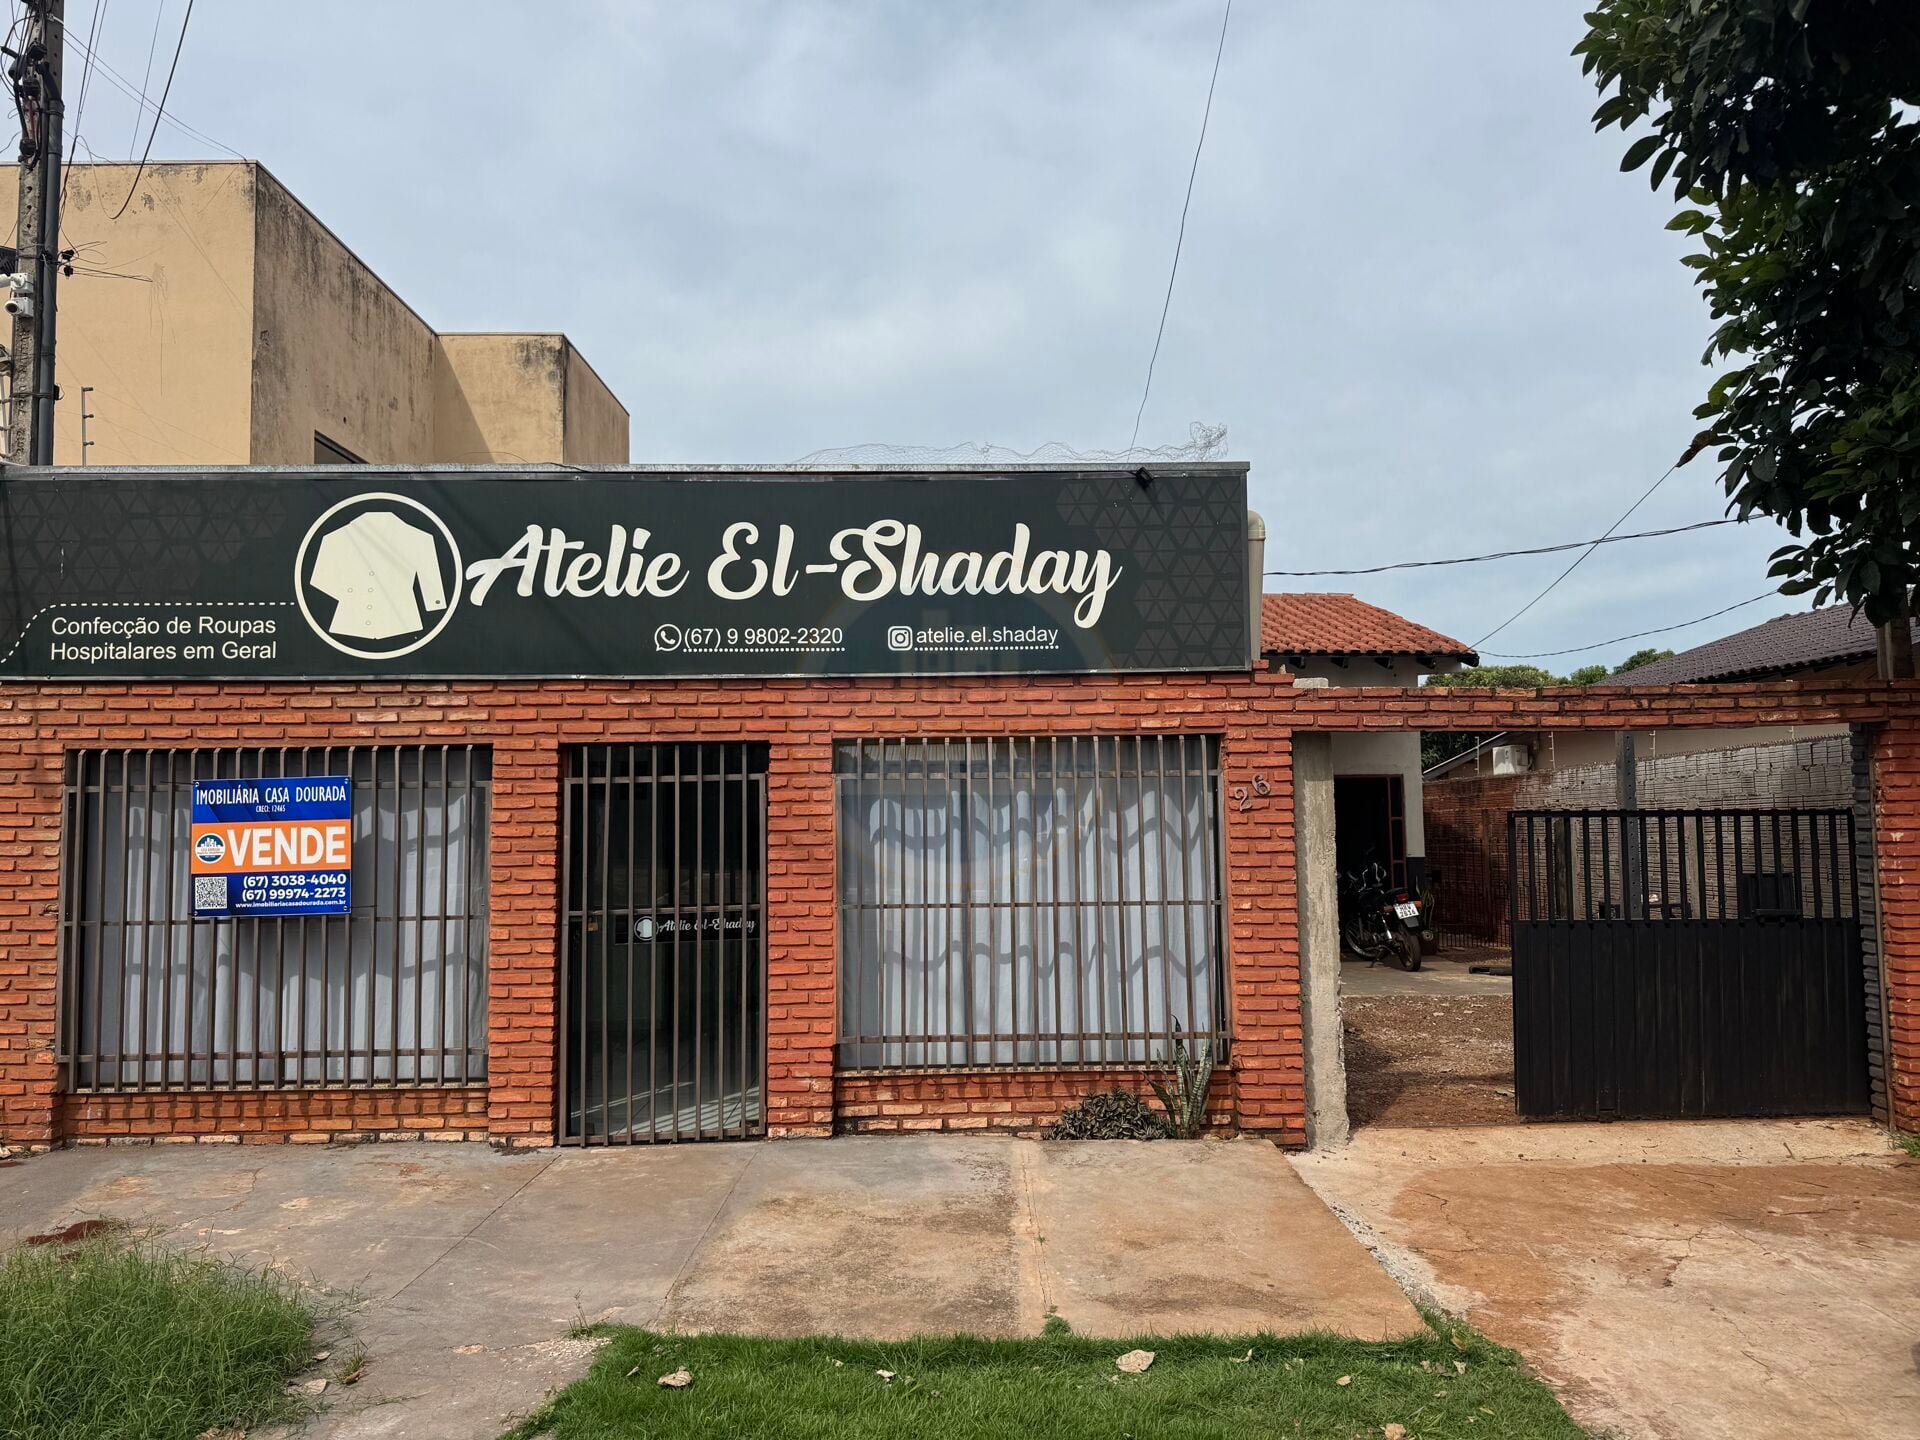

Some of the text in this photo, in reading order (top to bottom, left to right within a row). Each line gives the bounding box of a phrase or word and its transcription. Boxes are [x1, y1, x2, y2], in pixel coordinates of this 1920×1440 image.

[465, 519, 1123, 629] Atelie El-Shaday
[51, 616, 277, 639] Confecção de Roupas
[684, 627, 843, 649] (67) 9 9802-2320
[916, 626, 1059, 646] atelie.el.shaday
[50, 640, 277, 664] Hospitalares em Geral
[196, 785, 346, 805] IMOBILIÁRIA CASA DOURADA
[227, 826, 346, 866] VENDE
[243, 873, 346, 888] (67) 3038-4040
[235, 899, 346, 908] www.imobiliariacasadourada.com.br
[242, 887, 346, 902] (67) 99974-2273
